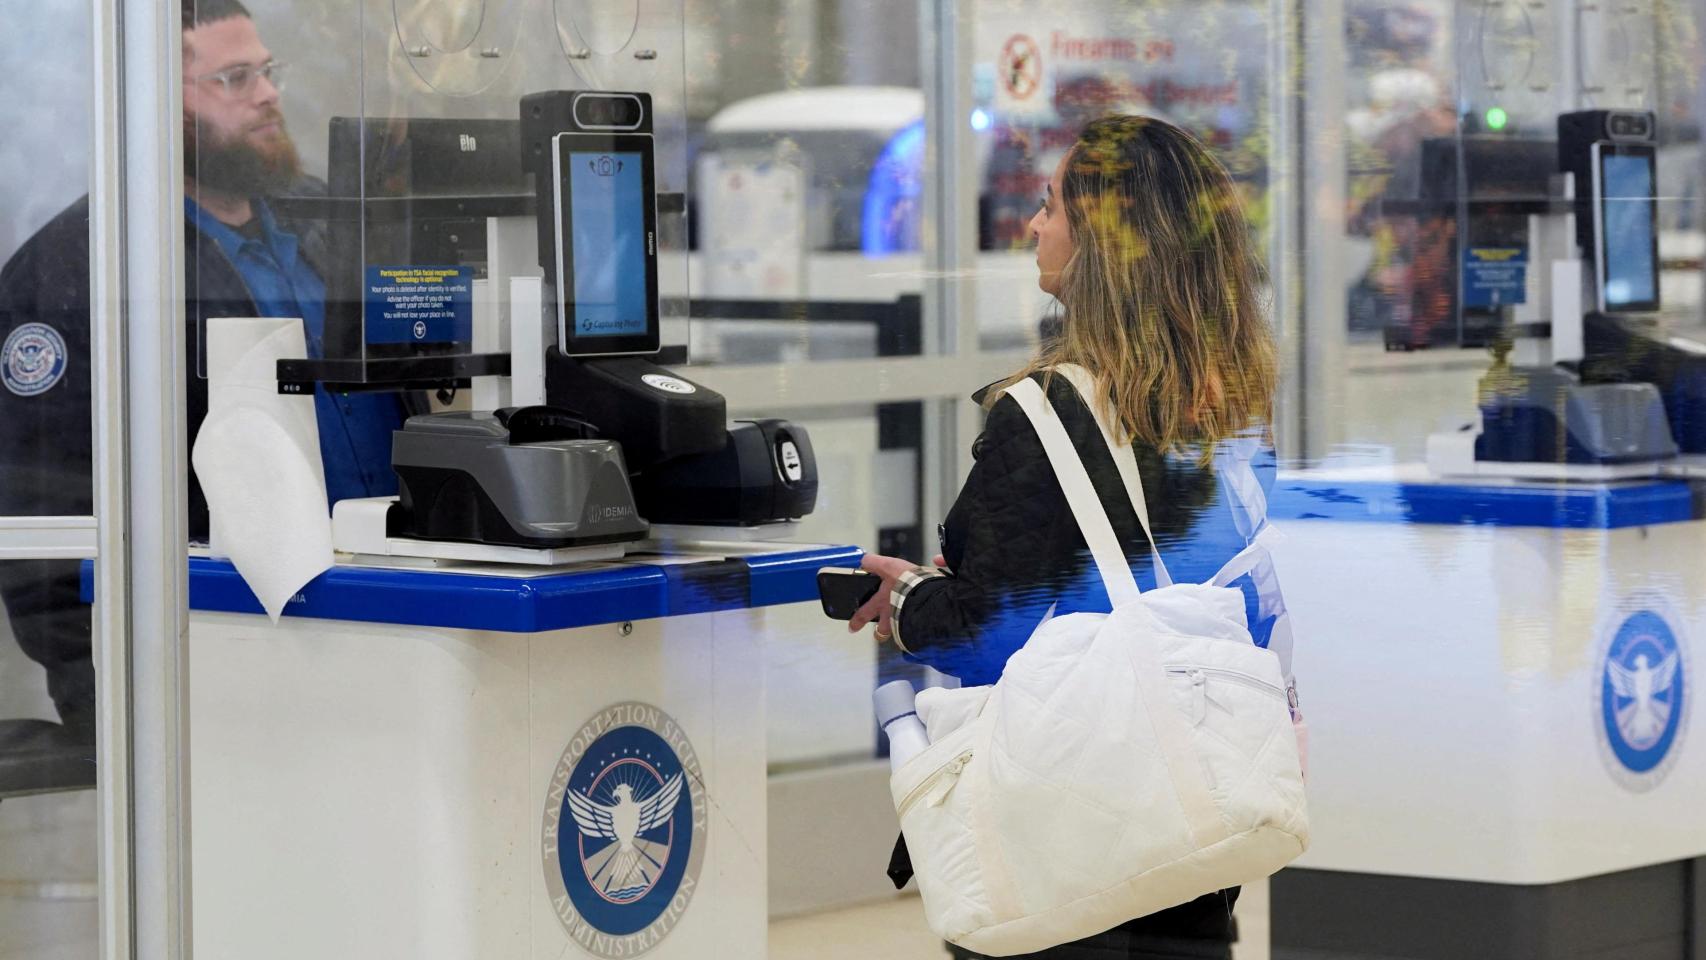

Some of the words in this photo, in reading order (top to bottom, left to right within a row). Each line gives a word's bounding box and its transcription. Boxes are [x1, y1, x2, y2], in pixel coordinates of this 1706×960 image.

[544, 705, 660, 859] TRANSPORTATION
[664, 719, 706, 832] SECURITY
[554, 873, 696, 957] ADMINISTRATION
